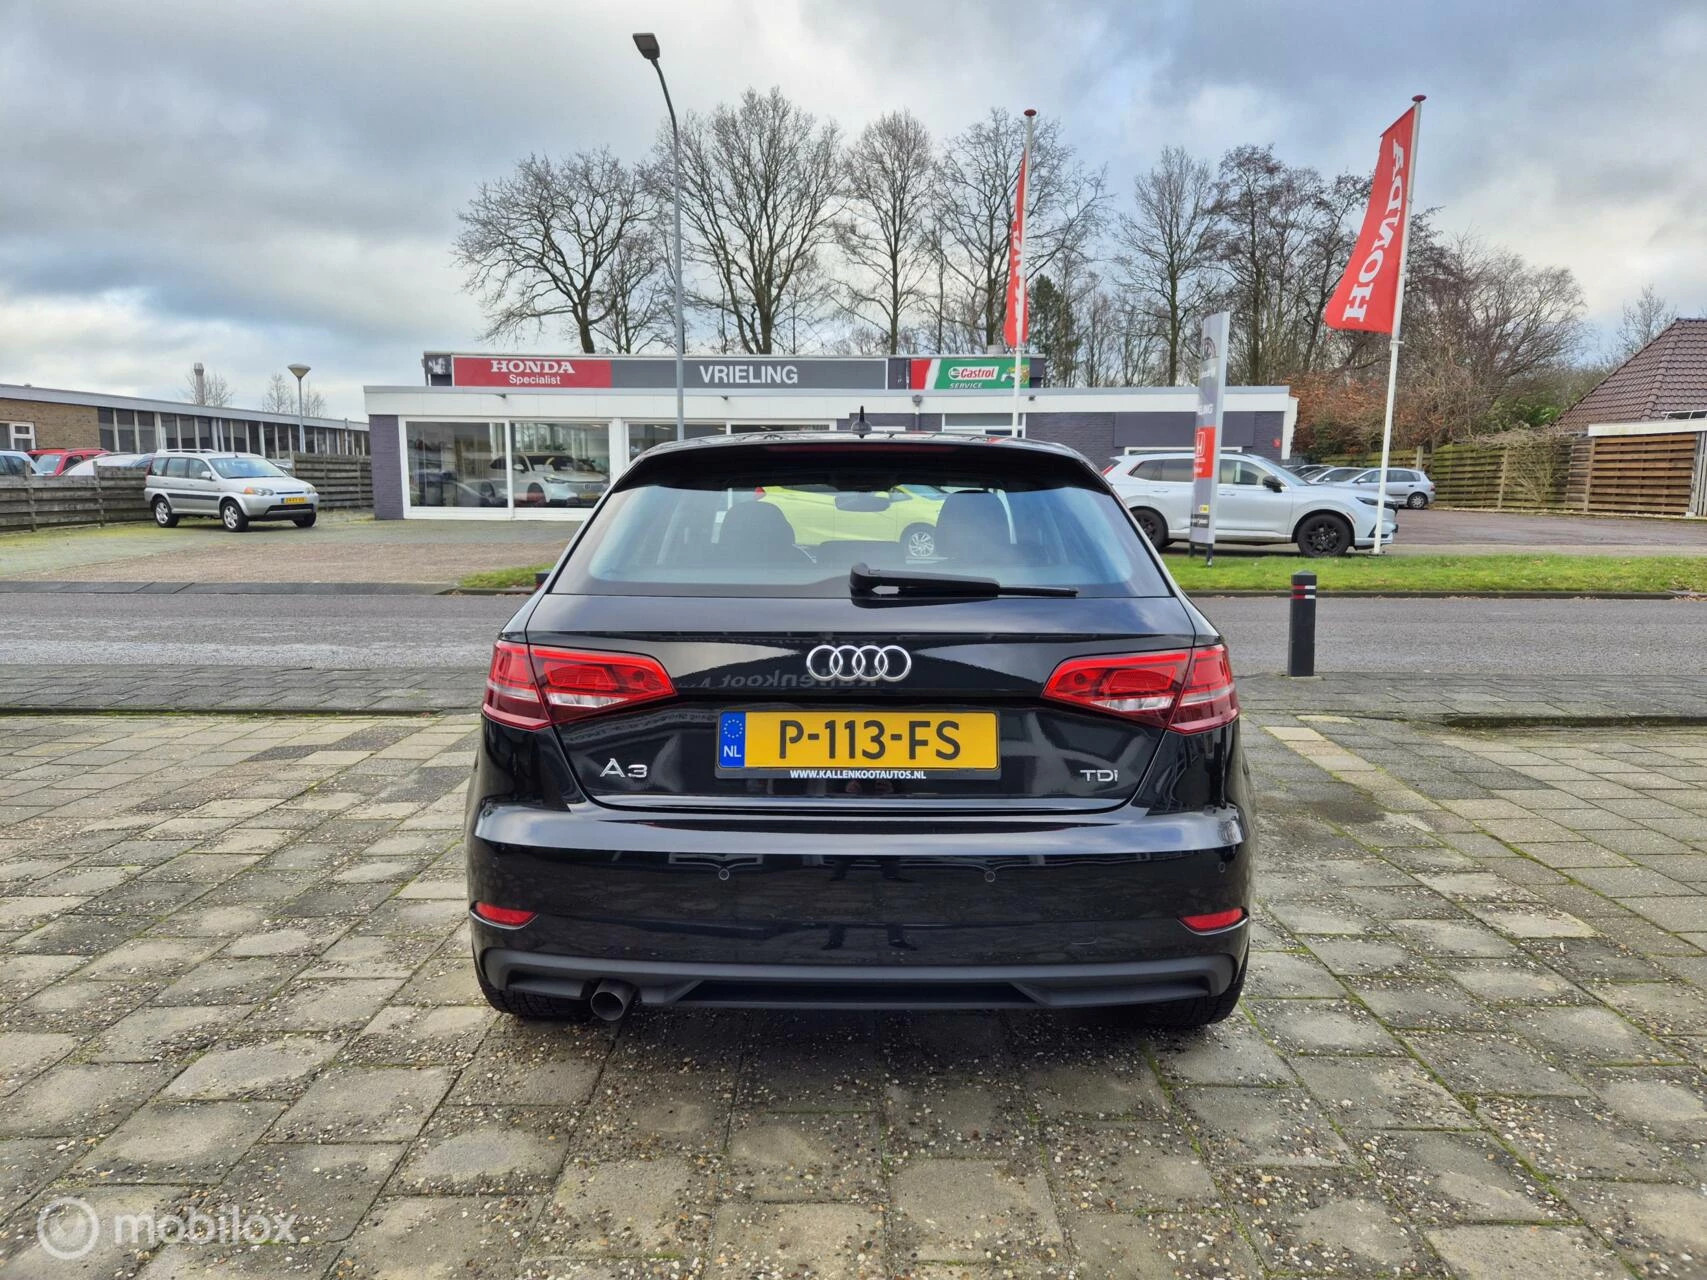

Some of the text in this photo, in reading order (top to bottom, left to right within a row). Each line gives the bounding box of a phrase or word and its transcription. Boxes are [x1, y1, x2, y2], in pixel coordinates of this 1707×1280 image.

[491, 360, 575, 374] HONDA
[960, 368, 995, 379] Castrol
[509, 374, 561, 385] Specialist
[699, 365, 798, 384] VRIELING
[779, 720, 961, 760] P-113-FS
[723, 745, 742, 758] NL
[599, 757, 648, 778] A3
[789, 769, 927, 779] WWW.KALLENKOOTAUTOS.NL
